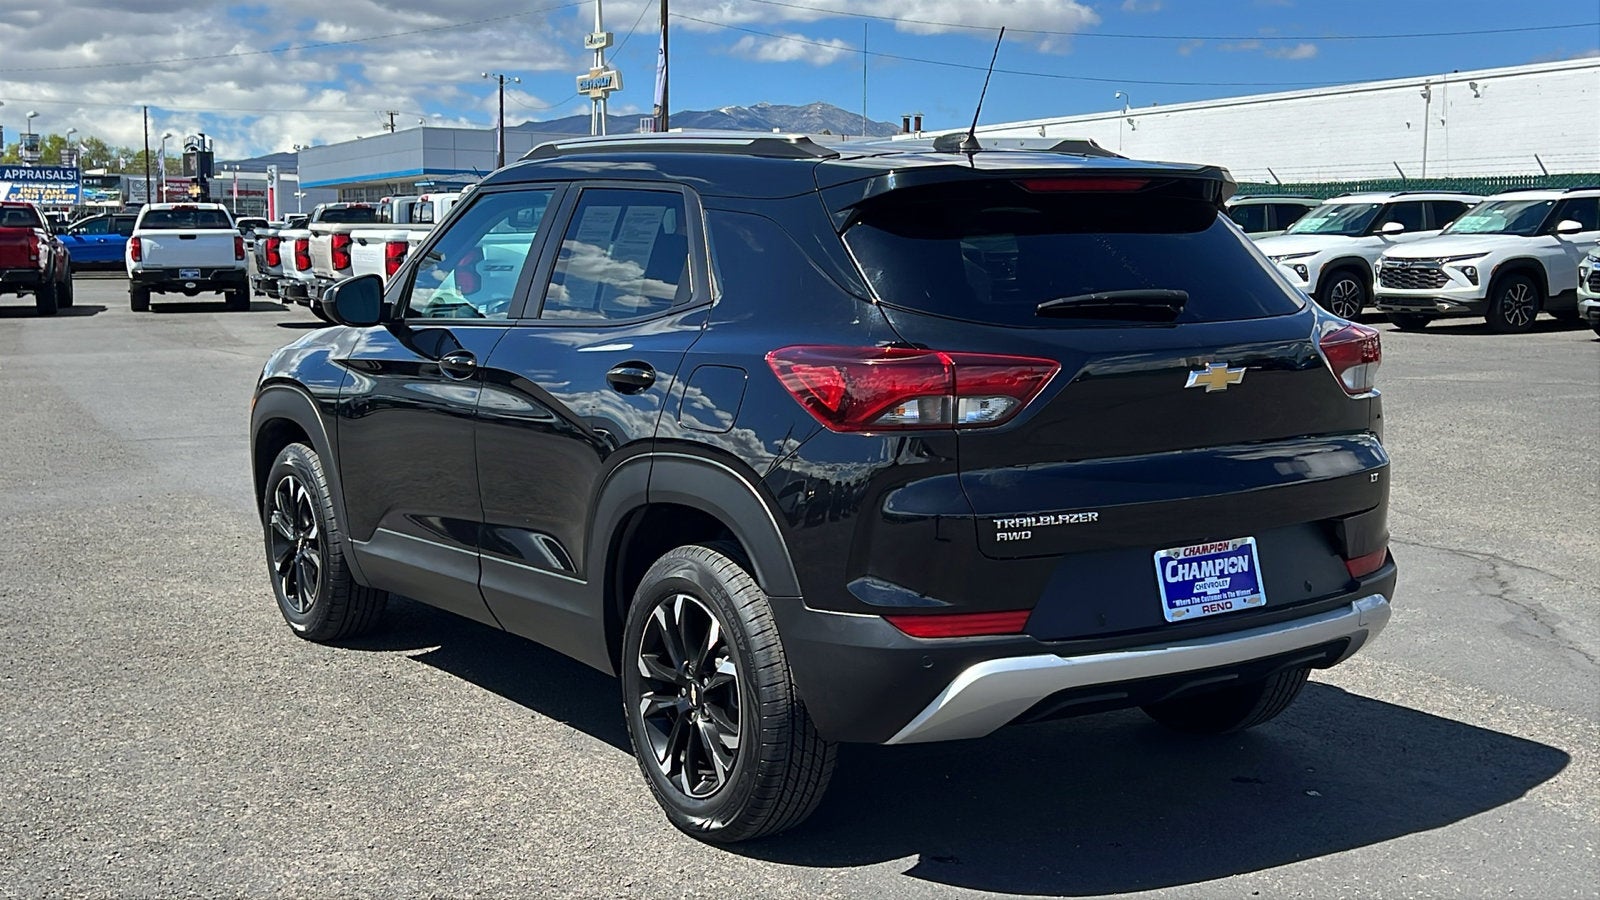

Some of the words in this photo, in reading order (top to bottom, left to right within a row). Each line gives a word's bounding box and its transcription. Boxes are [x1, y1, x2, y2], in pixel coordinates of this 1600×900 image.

[4, 169, 77, 180] APPRAISALS!
[20, 187, 67, 195] INSTANT
[993, 512, 1099, 529] TRAILBLAZER
[997, 531, 1032, 541] AWD
[1184, 542, 1230, 557] CHAMPION
[1165, 555, 1249, 583] CHAMPION
[1195, 580, 1229, 591] CHEVROLET
[1202, 601, 1233, 614] RENO
